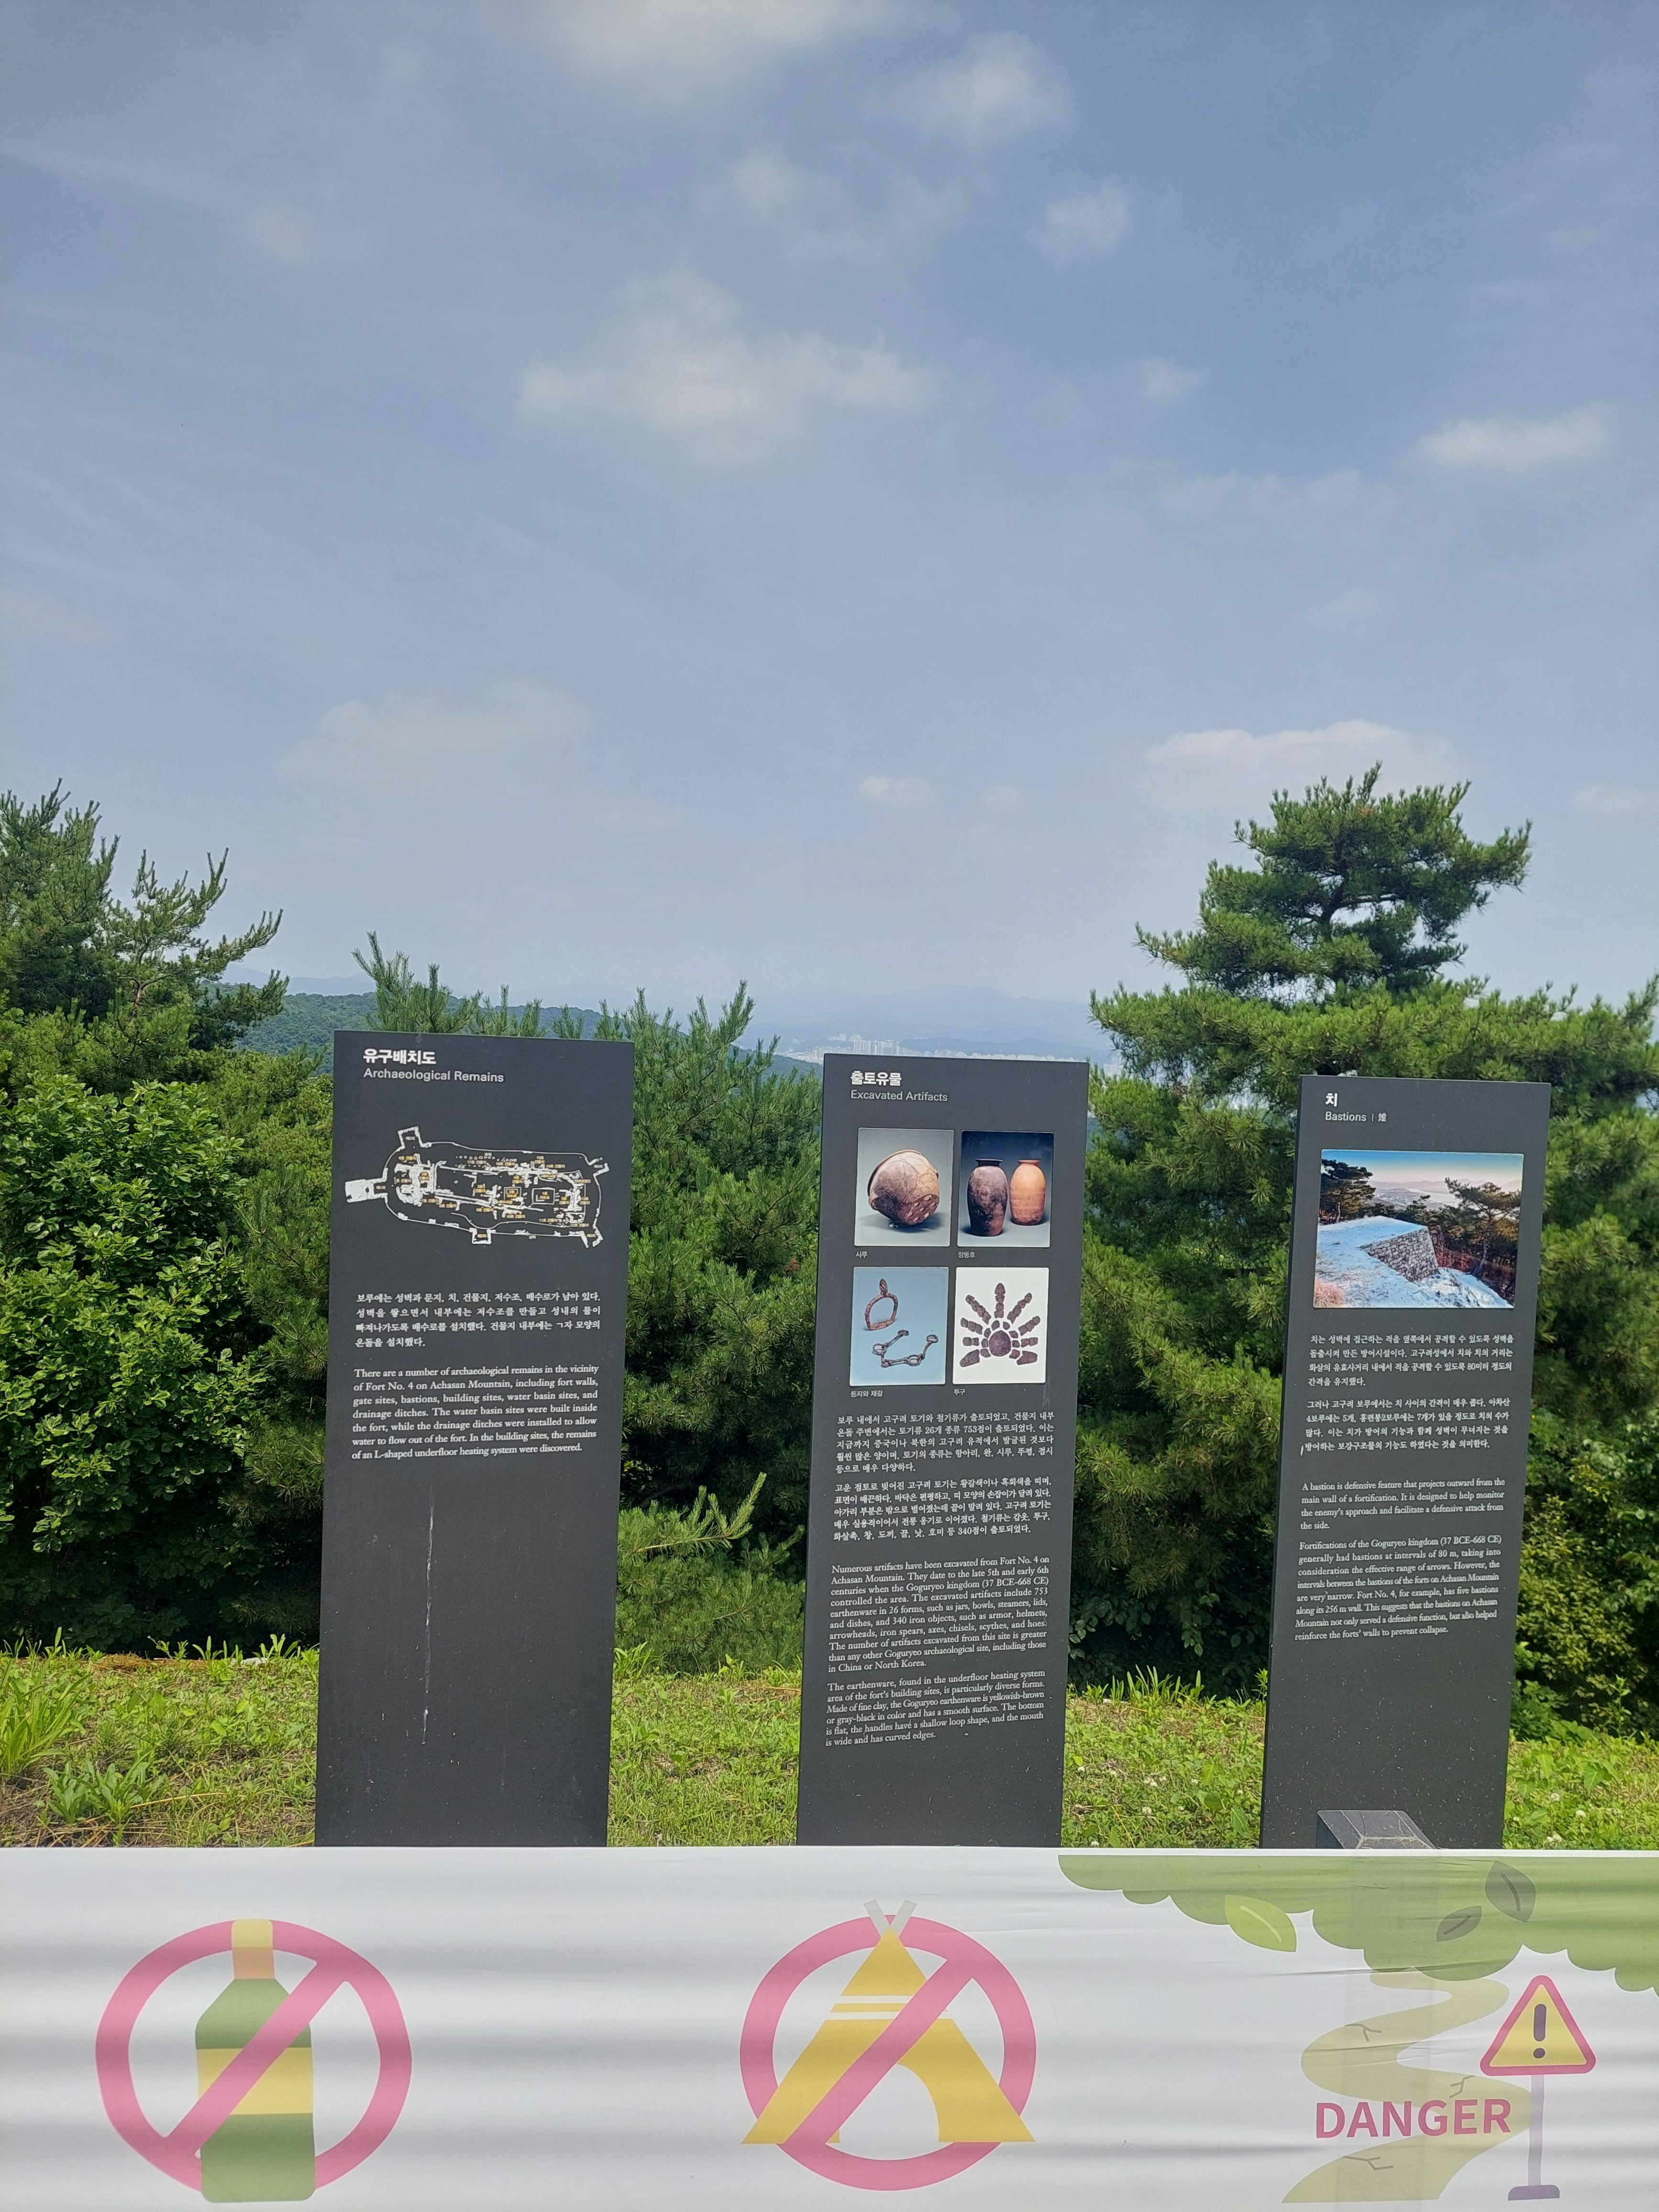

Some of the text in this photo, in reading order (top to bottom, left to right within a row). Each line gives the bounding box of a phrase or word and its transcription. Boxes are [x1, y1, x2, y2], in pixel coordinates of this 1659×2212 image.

[363, 1048, 436, 1065] 유구배치도
[363, 1067, 504, 1082] Archaeological Remains
[850, 1070, 902, 1086] 출토유물
[851, 1089, 948, 1101] Excavated Artifacts
[1325, 1093, 1338, 1107] 치
[1325, 1111, 1367, 1121] Bastions
[855, 1250, 868, 1259] 시루
[356, 1293, 393, 1303] 보루에는
[394, 1293, 422, 1303] 성벽과
[494, 1292, 522, 1302] 저수조,
[525, 1292, 560, 1302] 배수로가
[562, 1292, 580, 1301] 남아
[581, 1291, 601, 1301] 있다.
[355, 1305, 600, 1318] 성벽을 쌓으면서 내부에는 저수조를 만들고 성내의 물이
[355, 1322, 409, 1333] 빠져나가도록
[412, 1322, 447, 1332] 배수로를
[449, 1321, 487, 1331] 설치했다.
[489, 1321, 515, 1331] 건물지
[518, 1320, 553, 1330] 내부에는
[575, 1319, 600, 1329] 모양의
[354, 1337, 425, 1348] 온돌을 설치했다.
[1310, 1334, 1326, 1344] 치는
[1327, 1334, 1350, 1345] 성벽에
[1353, 1334, 1383, 1344] 접근하는
[1385, 1334, 1400, 1344] 적을
[1434, 1334, 1457, 1344] 공격할
[1458, 1334, 1466, 1344] 수
[1468, 1334, 1491, 1344] 있도록
[1492, 1334, 1514, 1344] 성벽을
[353, 1368, 381, 1377] There
[404, 1367, 439, 1376] number
[440, 1366, 451, 1375] of
[450, 1365, 509, 1377] archaeological
[510, 1365, 543, 1374] remains
[544, 1365, 553, 1373] in
[554, 1364, 568, 1373] the
[569, 1364, 599, 1374] vicinity
[353, 1382, 365, 1391] of
[365, 1382, 386, 1391] Fort
[387, 1381, 405, 1390] No.
[407, 1381, 414, 1390] 4
[429, 1380, 466, 1389] Achasan
[467, 1379, 513, 1389] Mountain,
[515, 1378, 555, 1389] including
[557, 1377, 574, 1386] fort
[575, 1376, 598, 1386] walls,
[353, 1398, 373, 1407] gate
[375, 1395, 398, 1405] sites,
[400, 1394, 440, 1404] bastions,
[442, 1393, 480, 1404] building
[482, 1393, 504, 1402] sites,
[533, 1391, 556, 1400] basin
[558, 1391, 580, 1400] sites,
[582, 1390, 598, 1398] and
[837, 1411, 1055, 1425] 보루 내에서 고구려 토기와 철기류가 출토되었고, 건물지 내부
[836, 1422, 1055, 1437] 온돌 주변에서는 토기류 26개 종류 753점이 출토되었다. 이는
[835, 1461, 916, 1474] 등으로 매우 다양하다.
[1301, 1477, 1505, 1491] A bastion is defensive feature that projects outward from the
[1301, 1495, 1320, 1504] main
[1321, 1494, 1337, 1503] wall
[1338, 1494, 1348, 1503] of
[1354, 1493, 1399, 1502] fortification.
[1400, 1493, 1408, 1501] It
[1408, 1493, 1415, 1501] is
[1416, 1491, 1448, 1502] designed
[1459, 1491, 1474, 1501] help
[1476, 1490, 1505, 1499] monitor
[1300, 1520, 1330, 1529] the side.
[831, 1564, 872, 1573] Numerous
[874, 1562, 904, 1571] artifacts
[905, 1560, 923, 1570] have
[924, 1560, 942, 1569] been
[943, 1558, 978, 1568] excavated
[980, 1557, 998, 1566] from
[999, 1557, 1016, 1565] Fort
[1017, 1556, 1032, 1564] No.
[1033, 1555, 1039, 1563] 4
[830, 1575, 863, 1584] Achasan
[864, 1573, 905, 1582] Mountain.
[907, 1571, 929, 1582] They
[929, 1571, 946, 1579] date
[957, 1569, 970, 1578] the
[971, 1569, 985, 1577] late
[987, 1567, 1000, 1576] 5th
[1001, 1567, 1015, 1575] and
[1017, 1566, 1036, 1576] early
[1036, 1565, 1049, 1574] 6th
[830, 1576, 1049, 1595] centuries when the Goguryeo kingdom (37 BCE-668 CE)
[1316, 2098, 1512, 2138] DANGER
